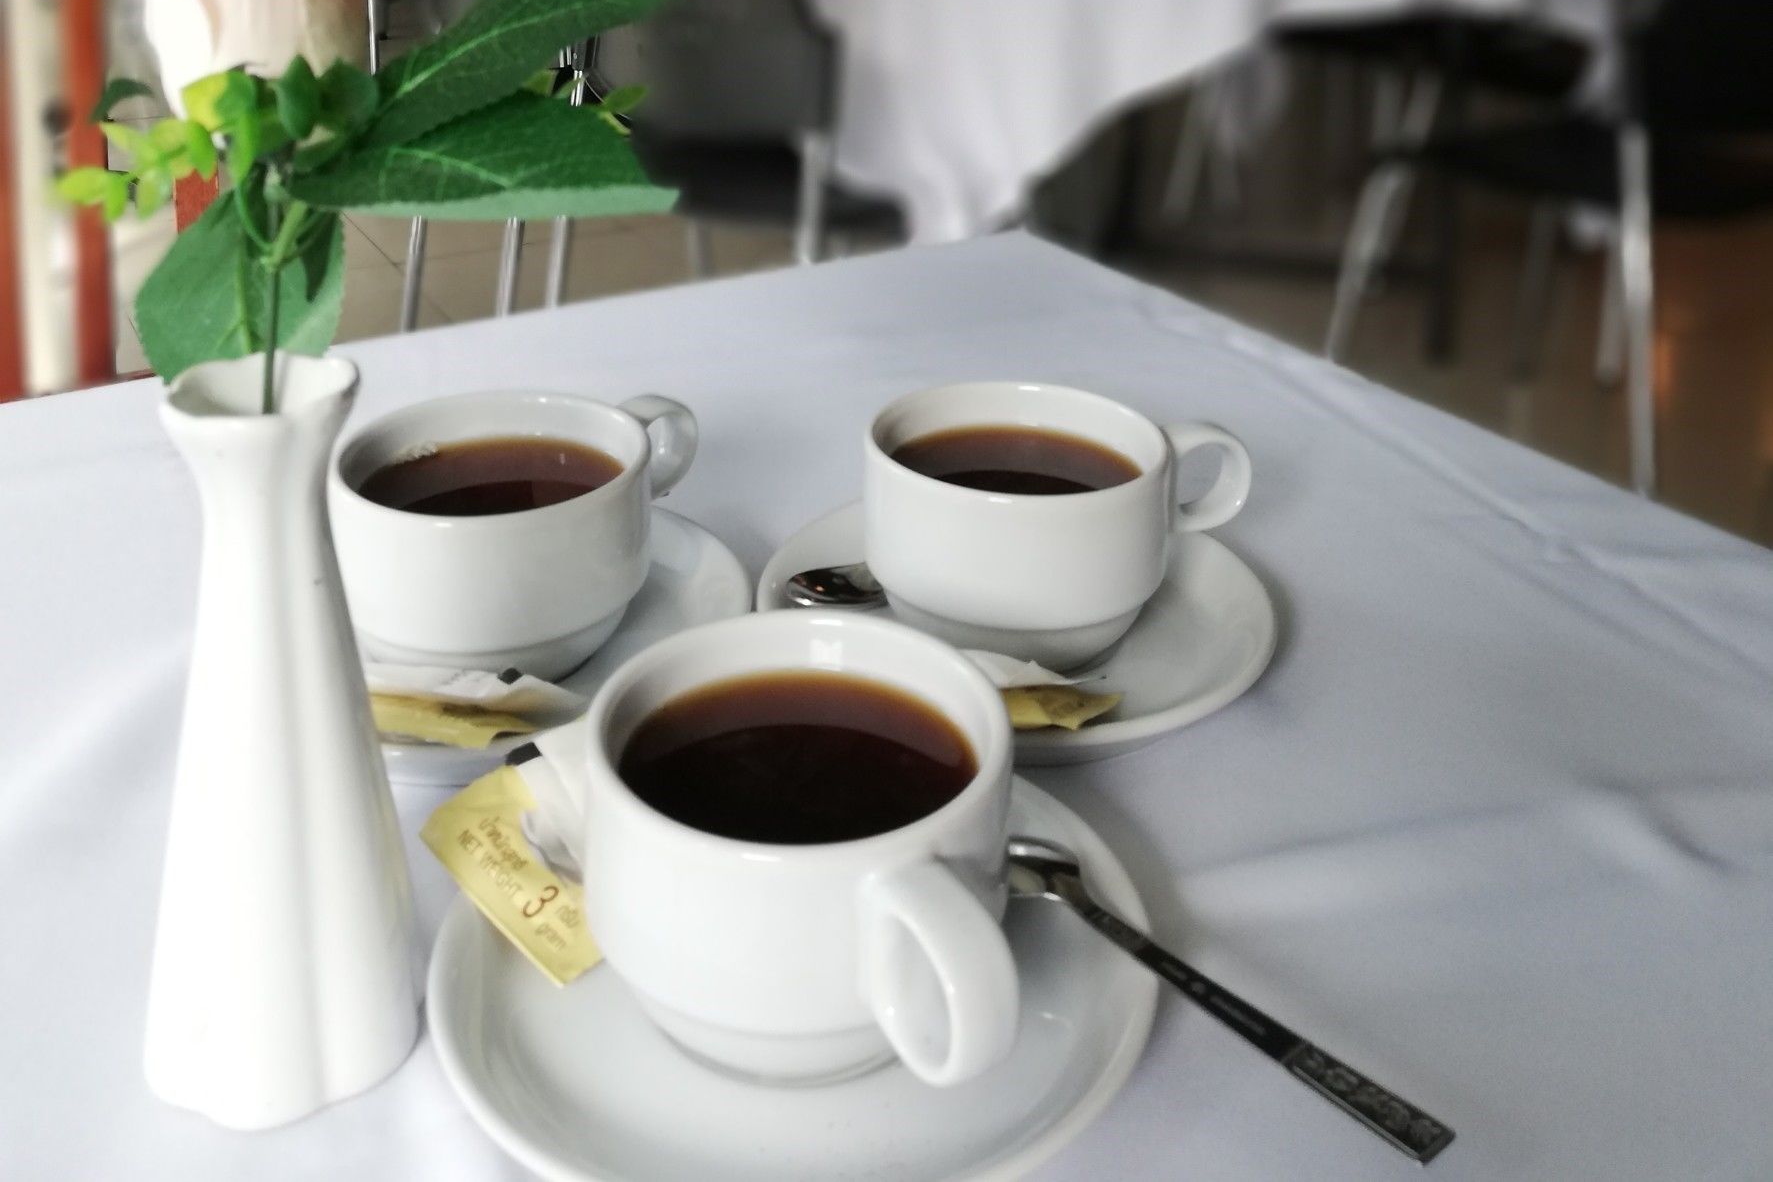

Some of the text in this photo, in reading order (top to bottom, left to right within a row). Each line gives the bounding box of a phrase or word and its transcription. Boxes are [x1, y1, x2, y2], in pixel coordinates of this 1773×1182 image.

[457, 829, 524, 898] NET WEIGHT
[522, 885, 559, 918] 3
[534, 922, 568, 952] gram
